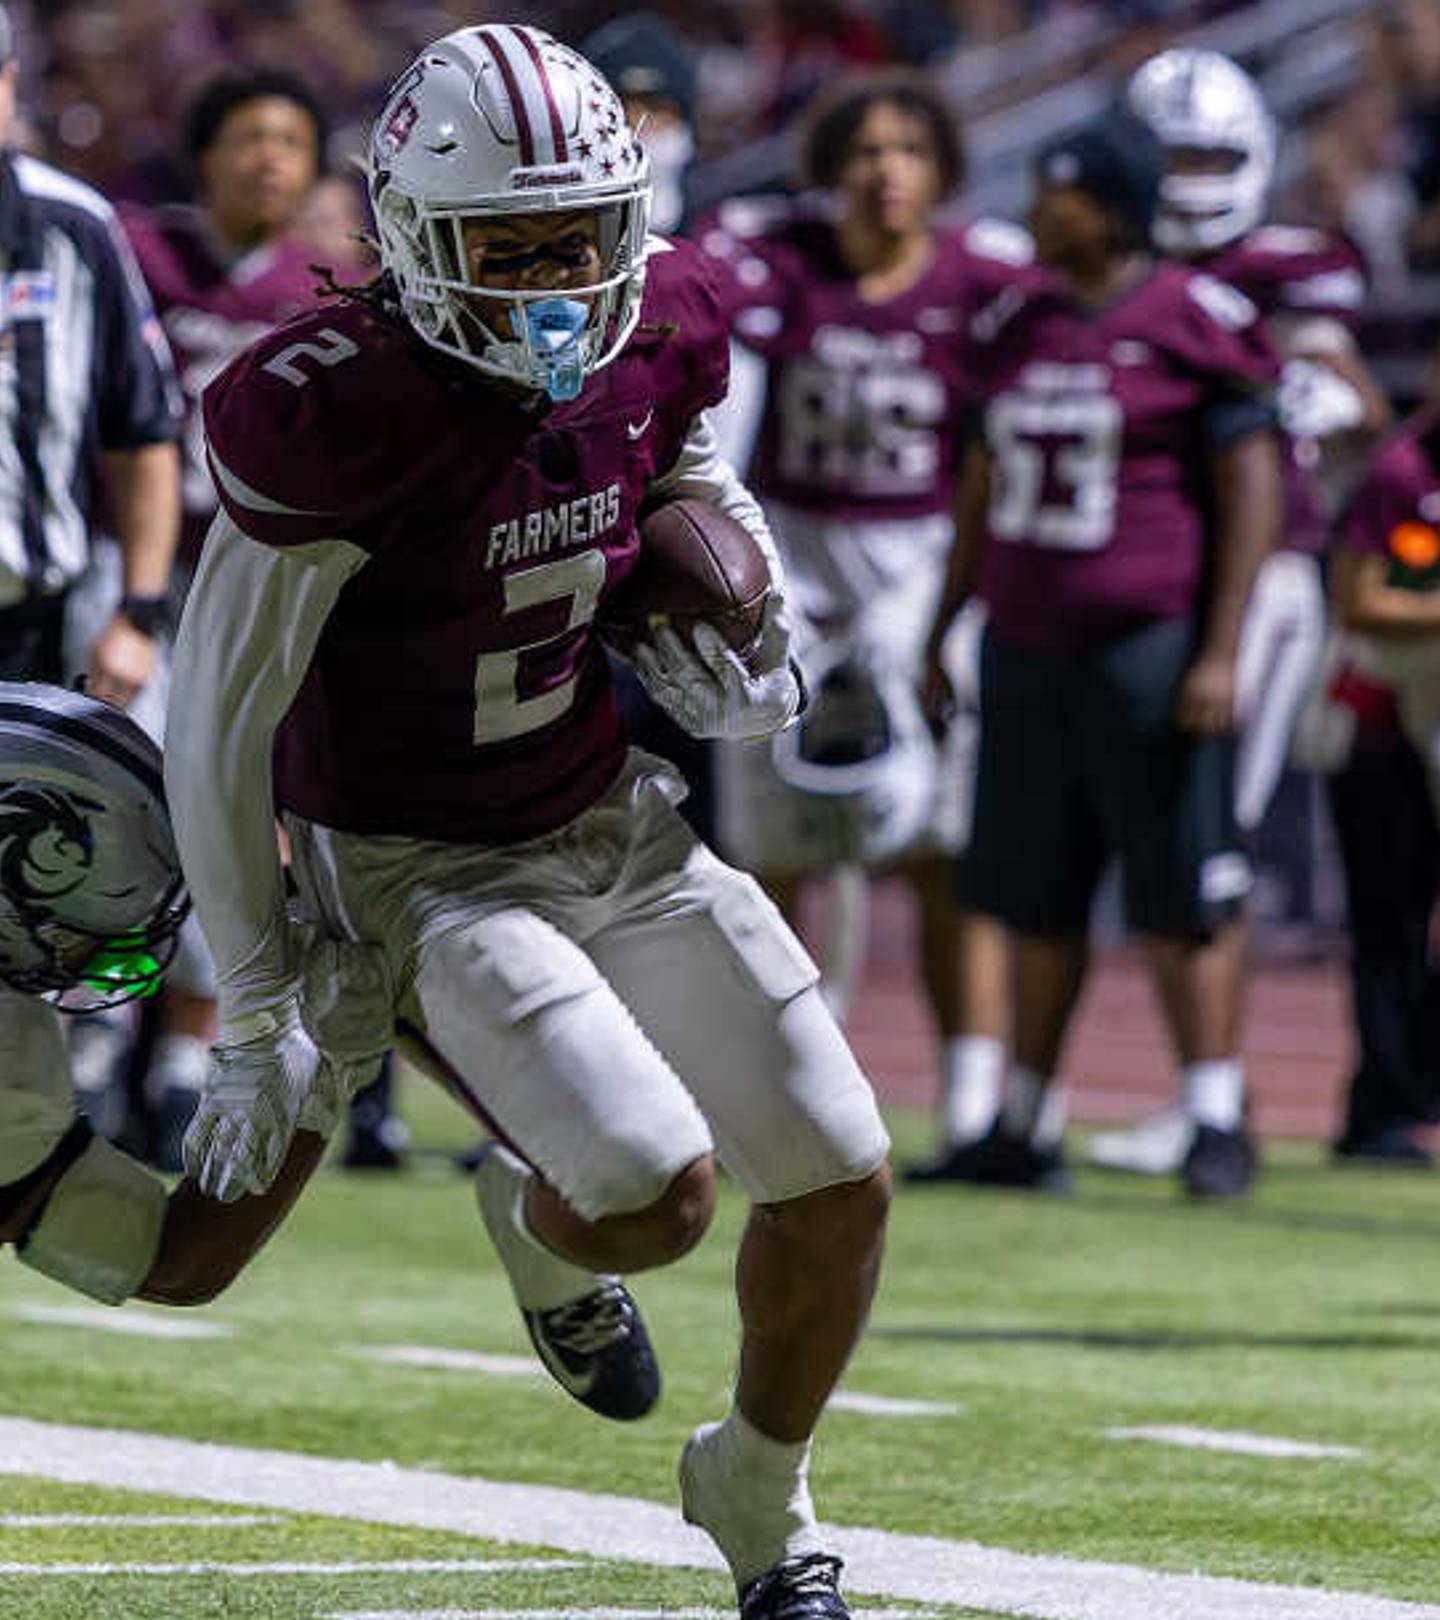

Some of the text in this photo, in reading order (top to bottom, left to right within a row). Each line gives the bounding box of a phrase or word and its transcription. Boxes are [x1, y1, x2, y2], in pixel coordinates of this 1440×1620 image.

[261, 327, 359, 387] 2
[484, 483, 620, 571] FARMERS
[473, 548, 606, 746] 2
